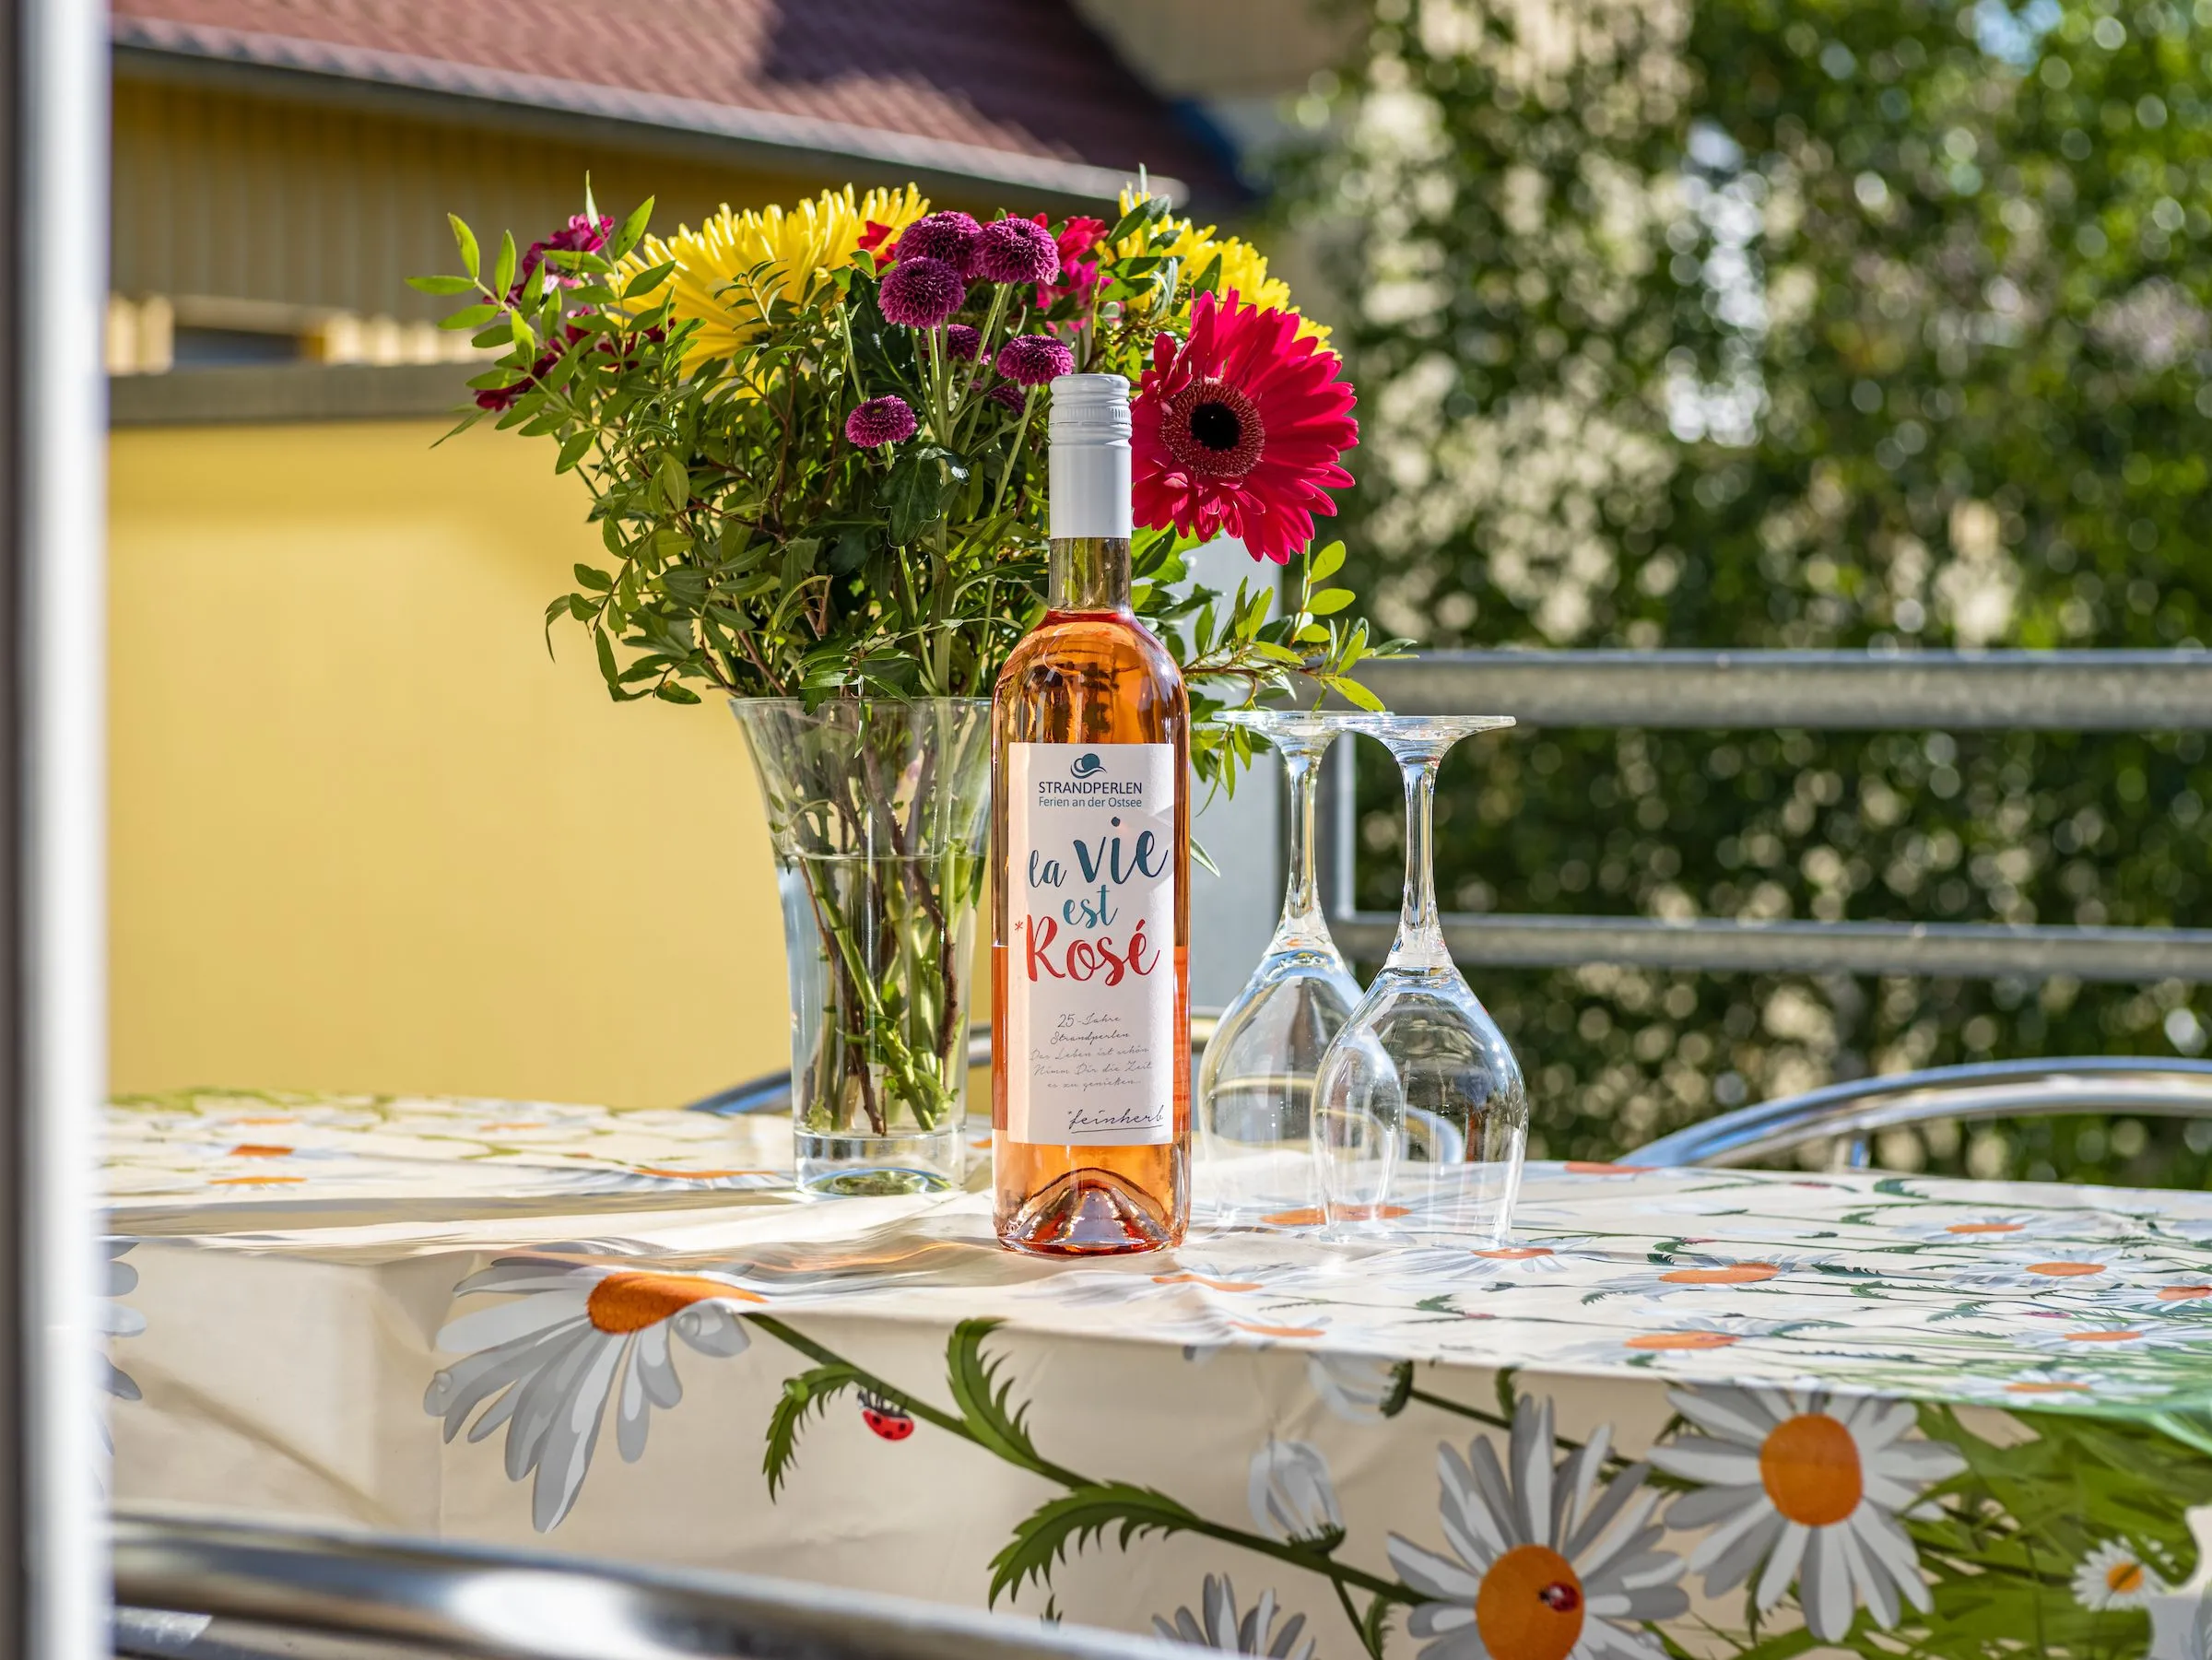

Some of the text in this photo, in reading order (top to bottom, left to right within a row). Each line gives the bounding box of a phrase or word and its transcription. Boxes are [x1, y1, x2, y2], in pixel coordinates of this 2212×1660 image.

[1038, 782, 1143, 795] STRANDPERLEN
[1038, 795, 1143, 807] Ferien an der Ostsee
[1029, 816, 1169, 889] la vie
[1063, 884, 1119, 929] est
[1050, 1030, 1130, 1045] Strandperlen
[1054, 1047, 1091, 1061] Leben
[1097, 1047, 1114, 1056] ist
[1033, 1064, 1069, 1076] Nimm
[1075, 1062, 1097, 1076] Dir
[1102, 1064, 1121, 1073] die
